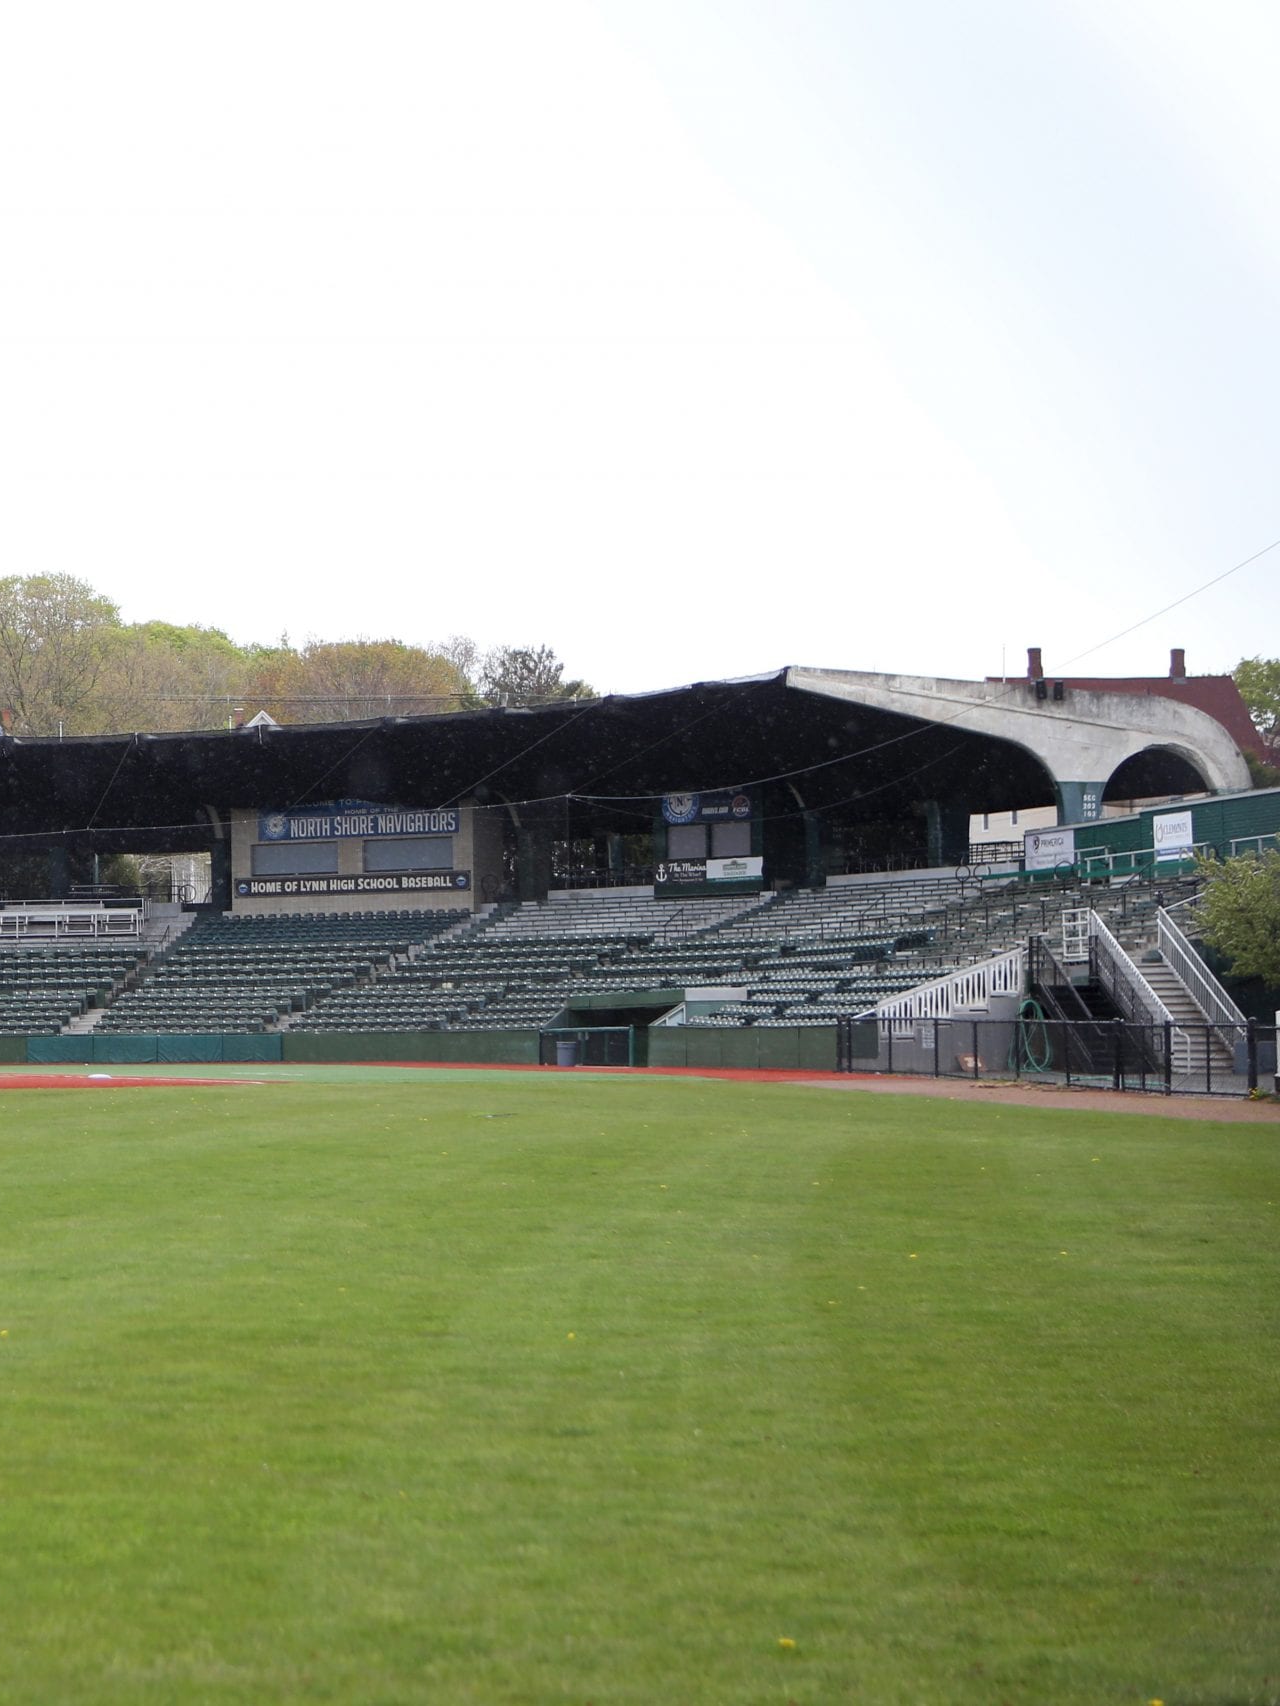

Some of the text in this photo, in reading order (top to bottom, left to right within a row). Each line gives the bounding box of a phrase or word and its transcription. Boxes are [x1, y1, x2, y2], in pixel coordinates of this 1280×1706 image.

[290, 812, 456, 838] NORTH SHORE NAVIGATORS
[668, 862, 706, 873] The Marina
[251, 875, 452, 893] HOME OF LYNN HIGH SCHOOL BASEBALL
